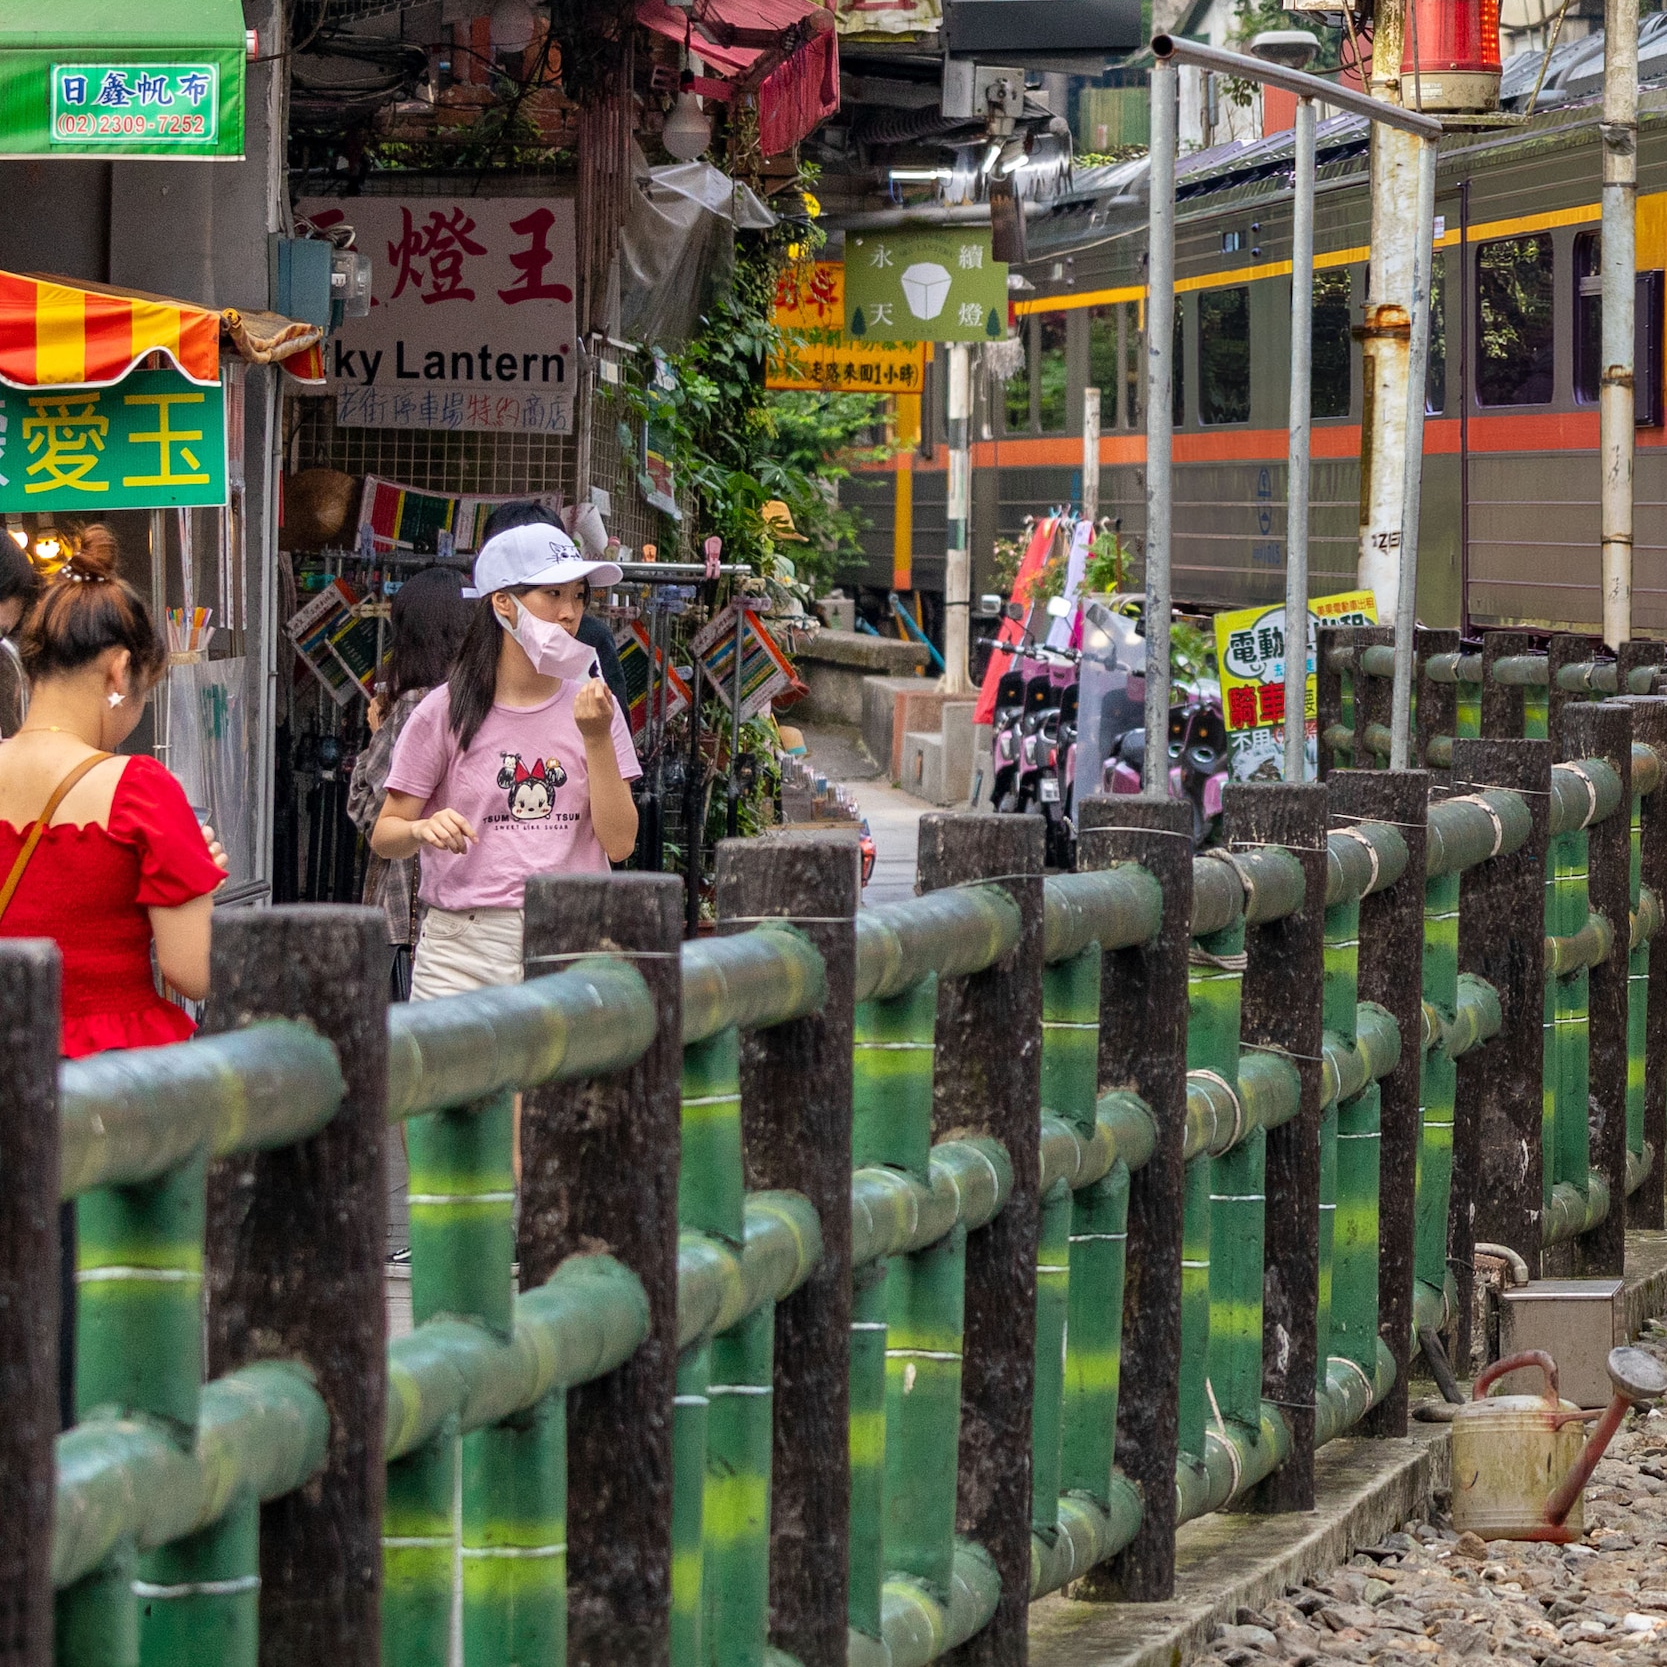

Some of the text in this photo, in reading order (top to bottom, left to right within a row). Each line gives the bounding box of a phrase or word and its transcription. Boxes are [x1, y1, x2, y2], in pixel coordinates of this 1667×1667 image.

[62, 71, 212, 108] 日鑫帆布
[57, 114, 206, 136] (02)2309-7252
[323, 339, 565, 386] ky Lantern
[0, 391, 210, 495] 愛玉
[482, 814, 510, 825] TSUM
[494, 823, 520, 831] SWEET
[544, 823, 569, 831] SUGAR
